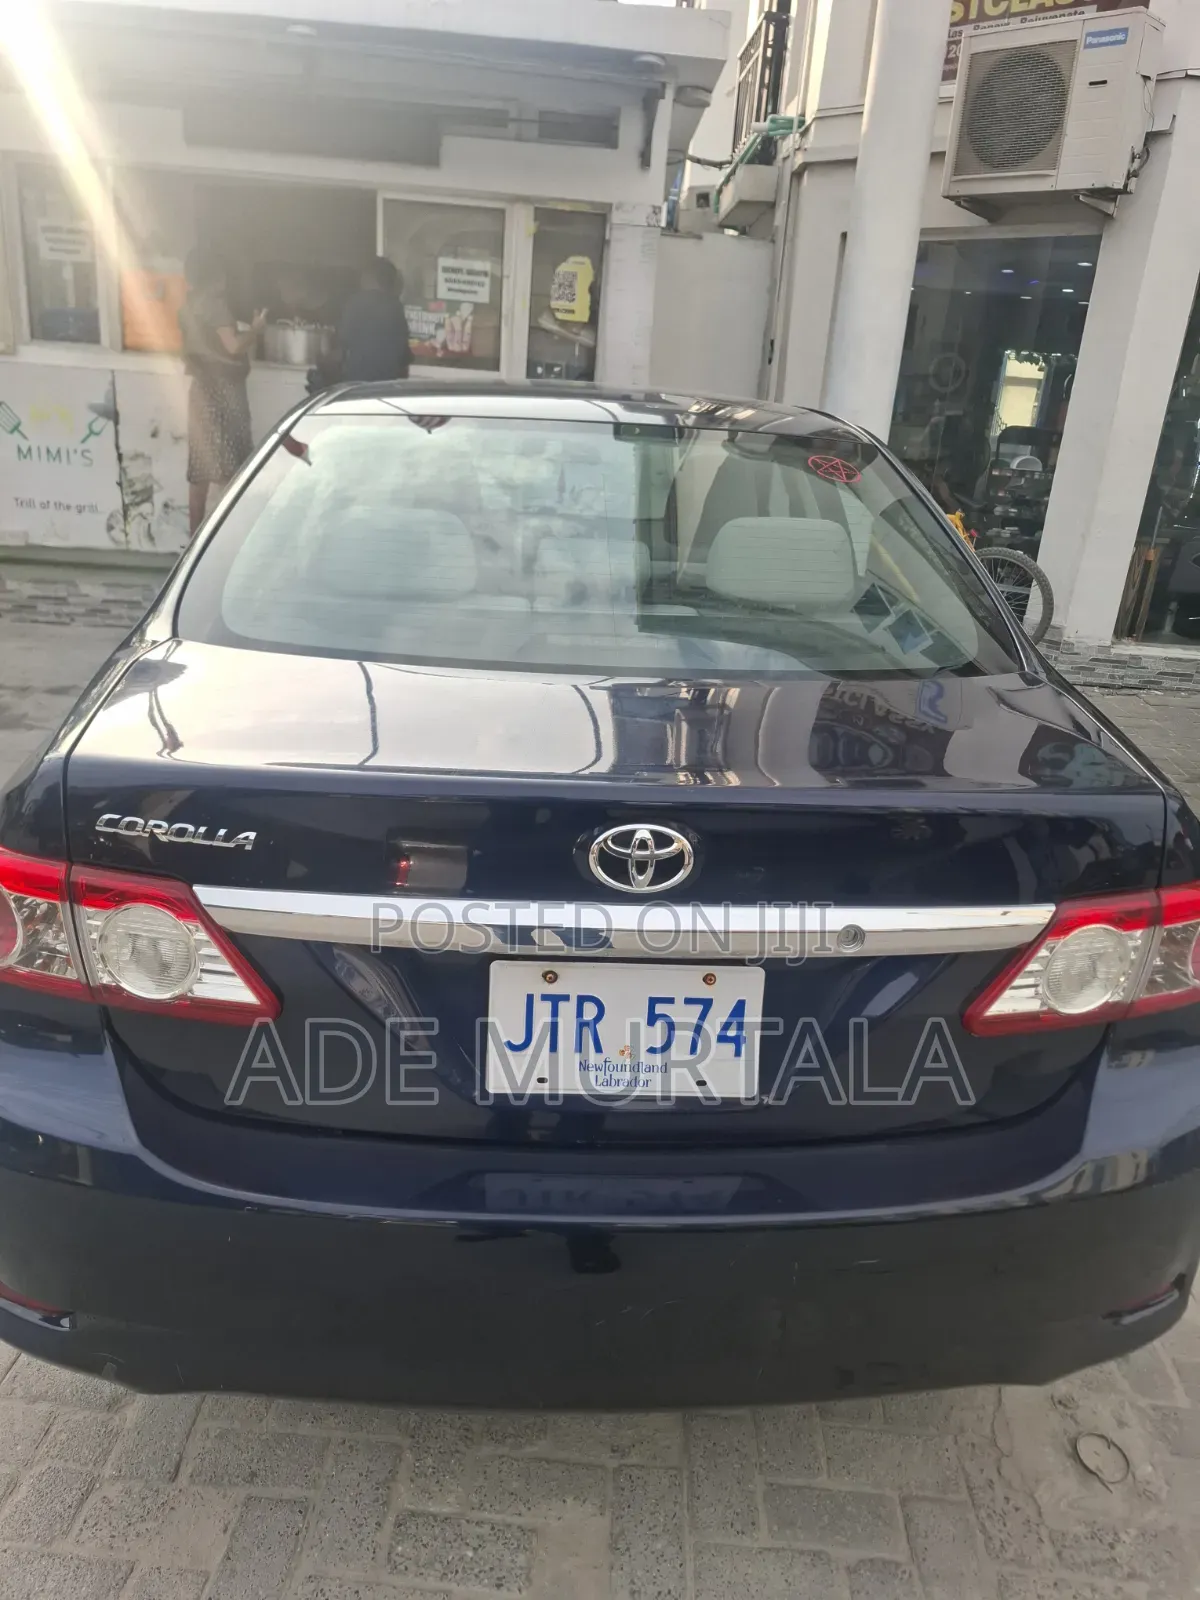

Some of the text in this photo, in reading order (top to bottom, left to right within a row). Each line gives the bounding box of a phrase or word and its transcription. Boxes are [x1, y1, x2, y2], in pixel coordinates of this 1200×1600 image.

[1086, 32, 1125, 45] Panasonic
[17, 443, 94, 468] MIMI'S
[39, 500, 50, 510] of
[53, 500, 72, 511] the
[95, 813, 257, 850] COROLLA
[503, 993, 747, 1058] JTR 574
[578, 1057, 667, 1074] Newfoundland
[595, 1075, 652, 1088] Labrador
